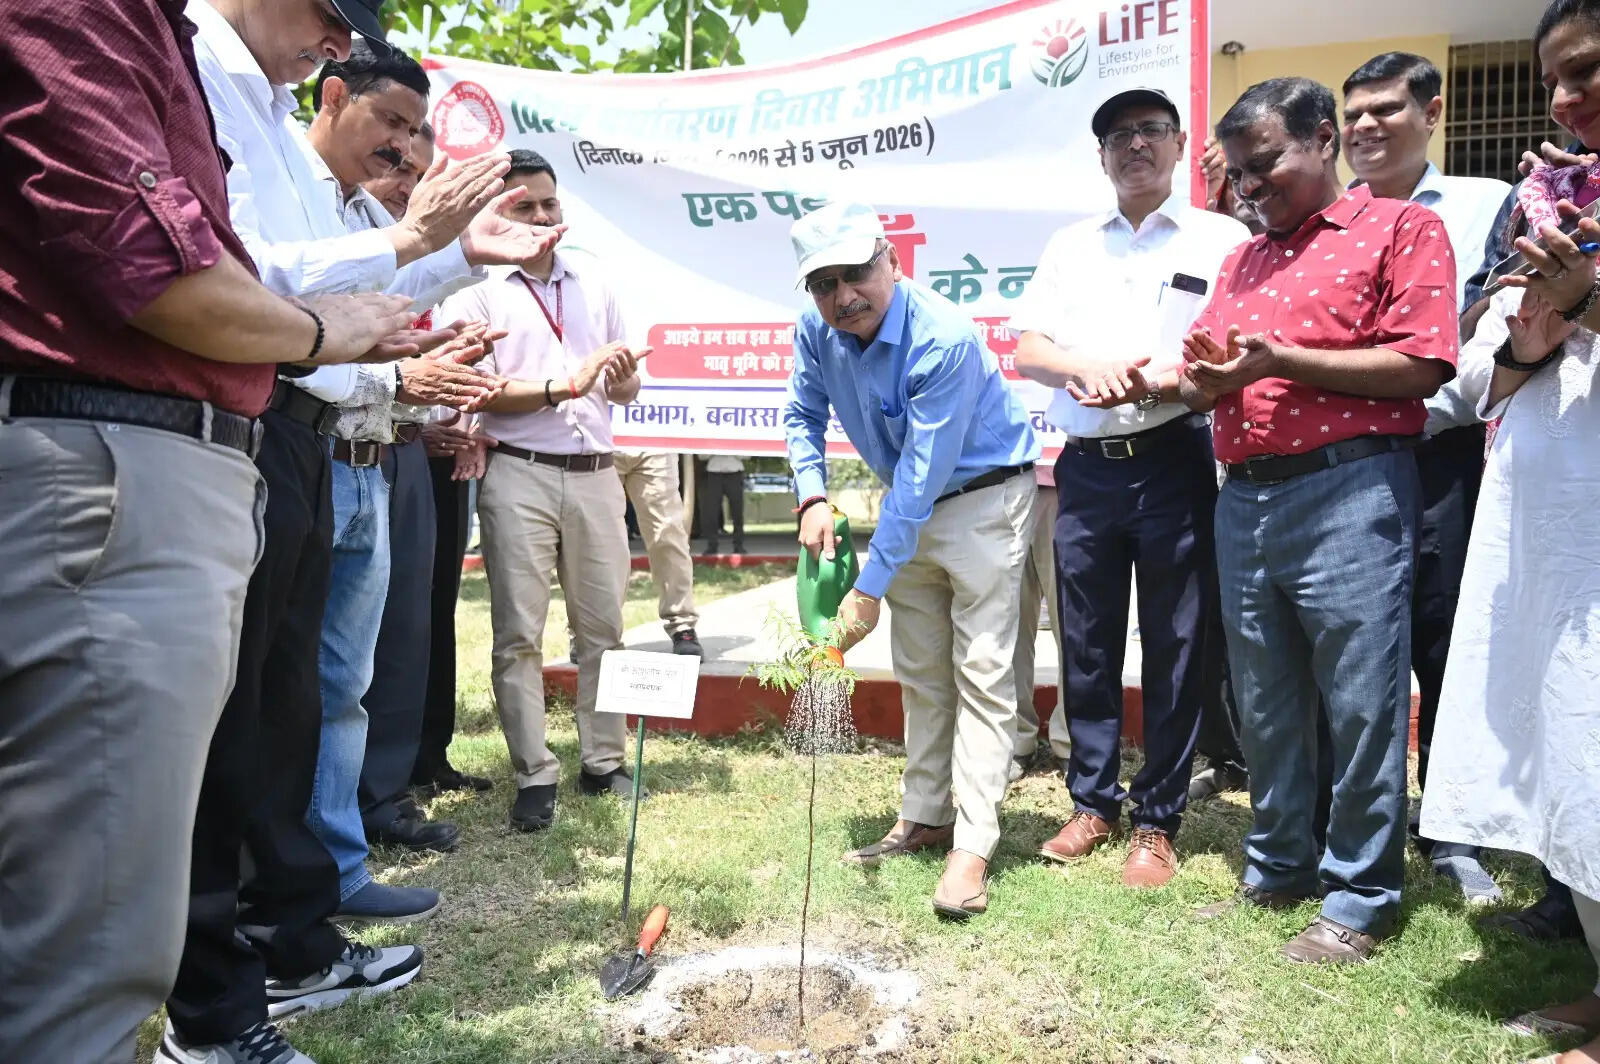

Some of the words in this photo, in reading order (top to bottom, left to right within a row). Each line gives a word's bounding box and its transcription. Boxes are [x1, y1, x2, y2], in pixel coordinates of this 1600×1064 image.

[1099, 0, 1179, 46] LiFE
[1098, 47, 1152, 66] Lifestyle
[1156, 43, 1174, 56] for
[1098, 56, 1180, 79] Environment
[853, 43, 1017, 118] अभियान
[774, 138, 797, 170] से
[802, 140, 814, 164] 5
[819, 133, 869, 170] जून
[873, 116, 935, 157] 2026)
[681, 192, 758, 228] एक
[928, 253, 989, 306] के
[664, 326, 700, 347] आइये
[702, 329, 724, 345] हम
[725, 329, 748, 345] सब
[749, 329, 771, 347] इस
[761, 351, 782, 371] को
[624, 399, 696, 427] विभाग,
[706, 406, 780, 428] बनारस
